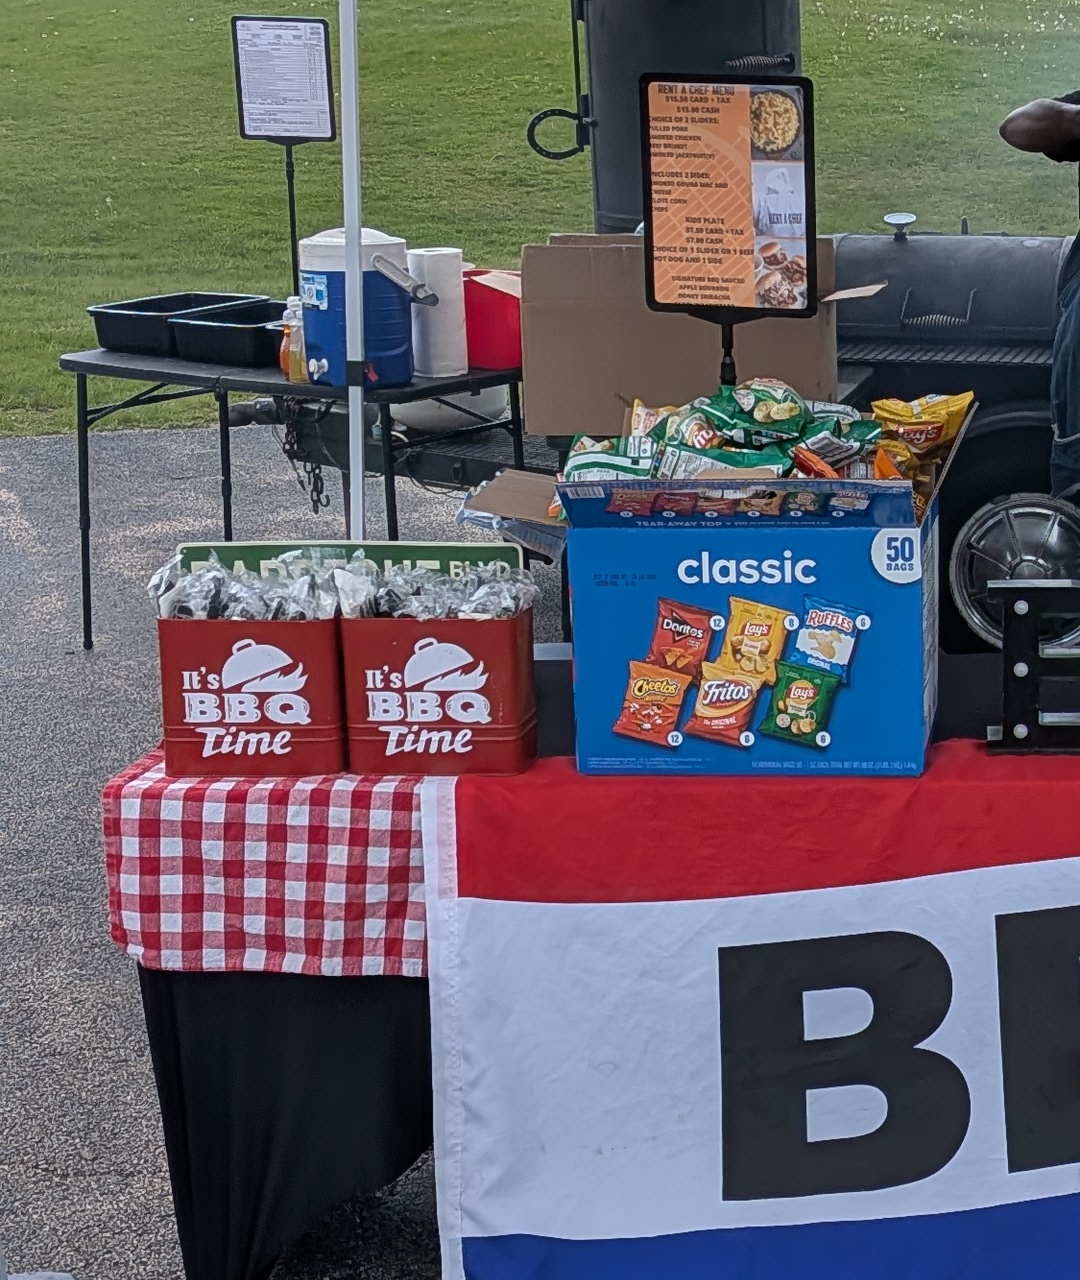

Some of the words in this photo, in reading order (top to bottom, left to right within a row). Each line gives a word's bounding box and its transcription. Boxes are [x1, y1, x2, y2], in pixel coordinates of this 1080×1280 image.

[658, 84, 678, 94] RENT
[681, 85, 687, 94] A
[689, 85, 709, 95] CHEF
[712, 86, 735, 97] MENU
[704, 217, 725, 225] PLATE
[886, 536, 914, 562] 50
[677, 551, 818, 585] classic
[886, 563, 915, 571] BAGS
[663, 619, 703, 638] Doritos
[712, 618, 722, 628] 12
[743, 622, 769, 637] Lay's
[808, 610, 853, 632] RUFFLES
[182, 667, 220, 690] It's
[365, 665, 402, 689] It's
[633, 678, 679, 697] Cheetos
[703, 680, 752, 705] Fritos
[790, 686, 815, 701] Lay's
[182, 692, 312, 725] BBQ
[366, 690, 492, 725] BBQ
[195, 725, 293, 758] Time
[378, 724, 474, 756] Time
[670, 733, 680, 743] 12
